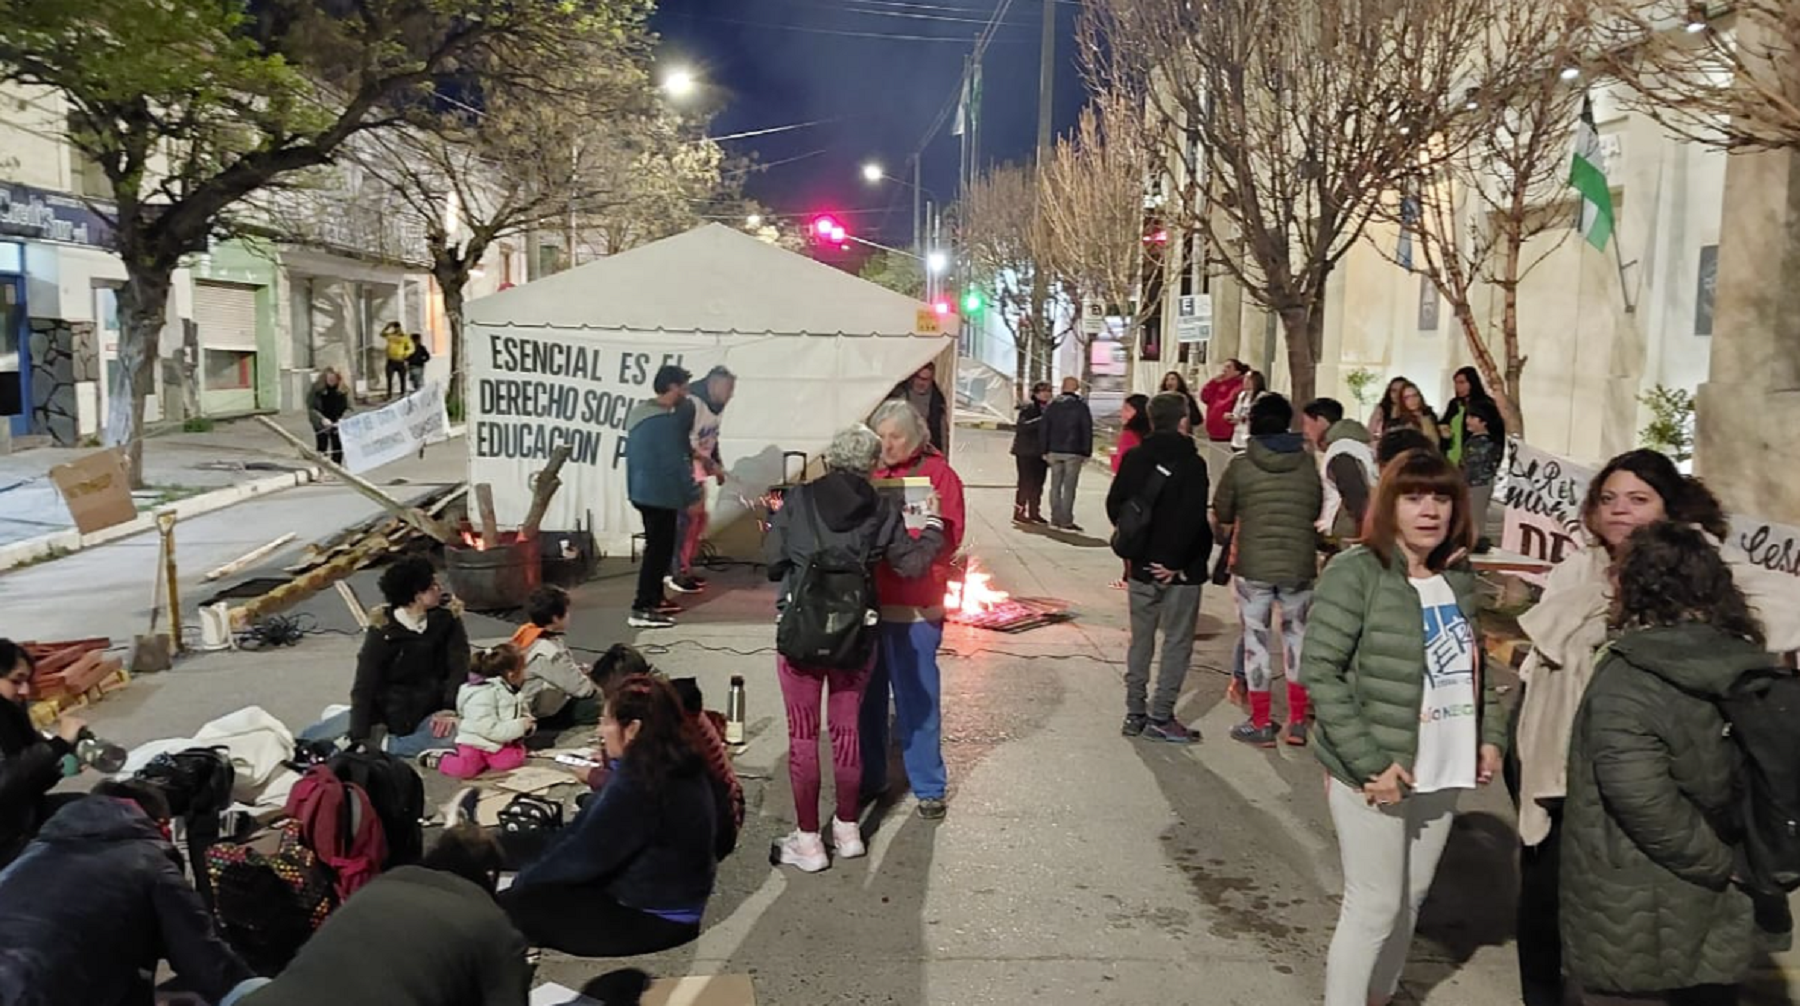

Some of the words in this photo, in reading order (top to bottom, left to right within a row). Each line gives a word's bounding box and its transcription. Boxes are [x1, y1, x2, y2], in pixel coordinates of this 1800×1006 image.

[490, 335, 602, 381] ESENCIAL
[618, 351, 650, 385] ES
[480, 378, 579, 421] DERECHO
[581, 389, 645, 431] SOCI
[476, 421, 602, 466] EDUCACION
